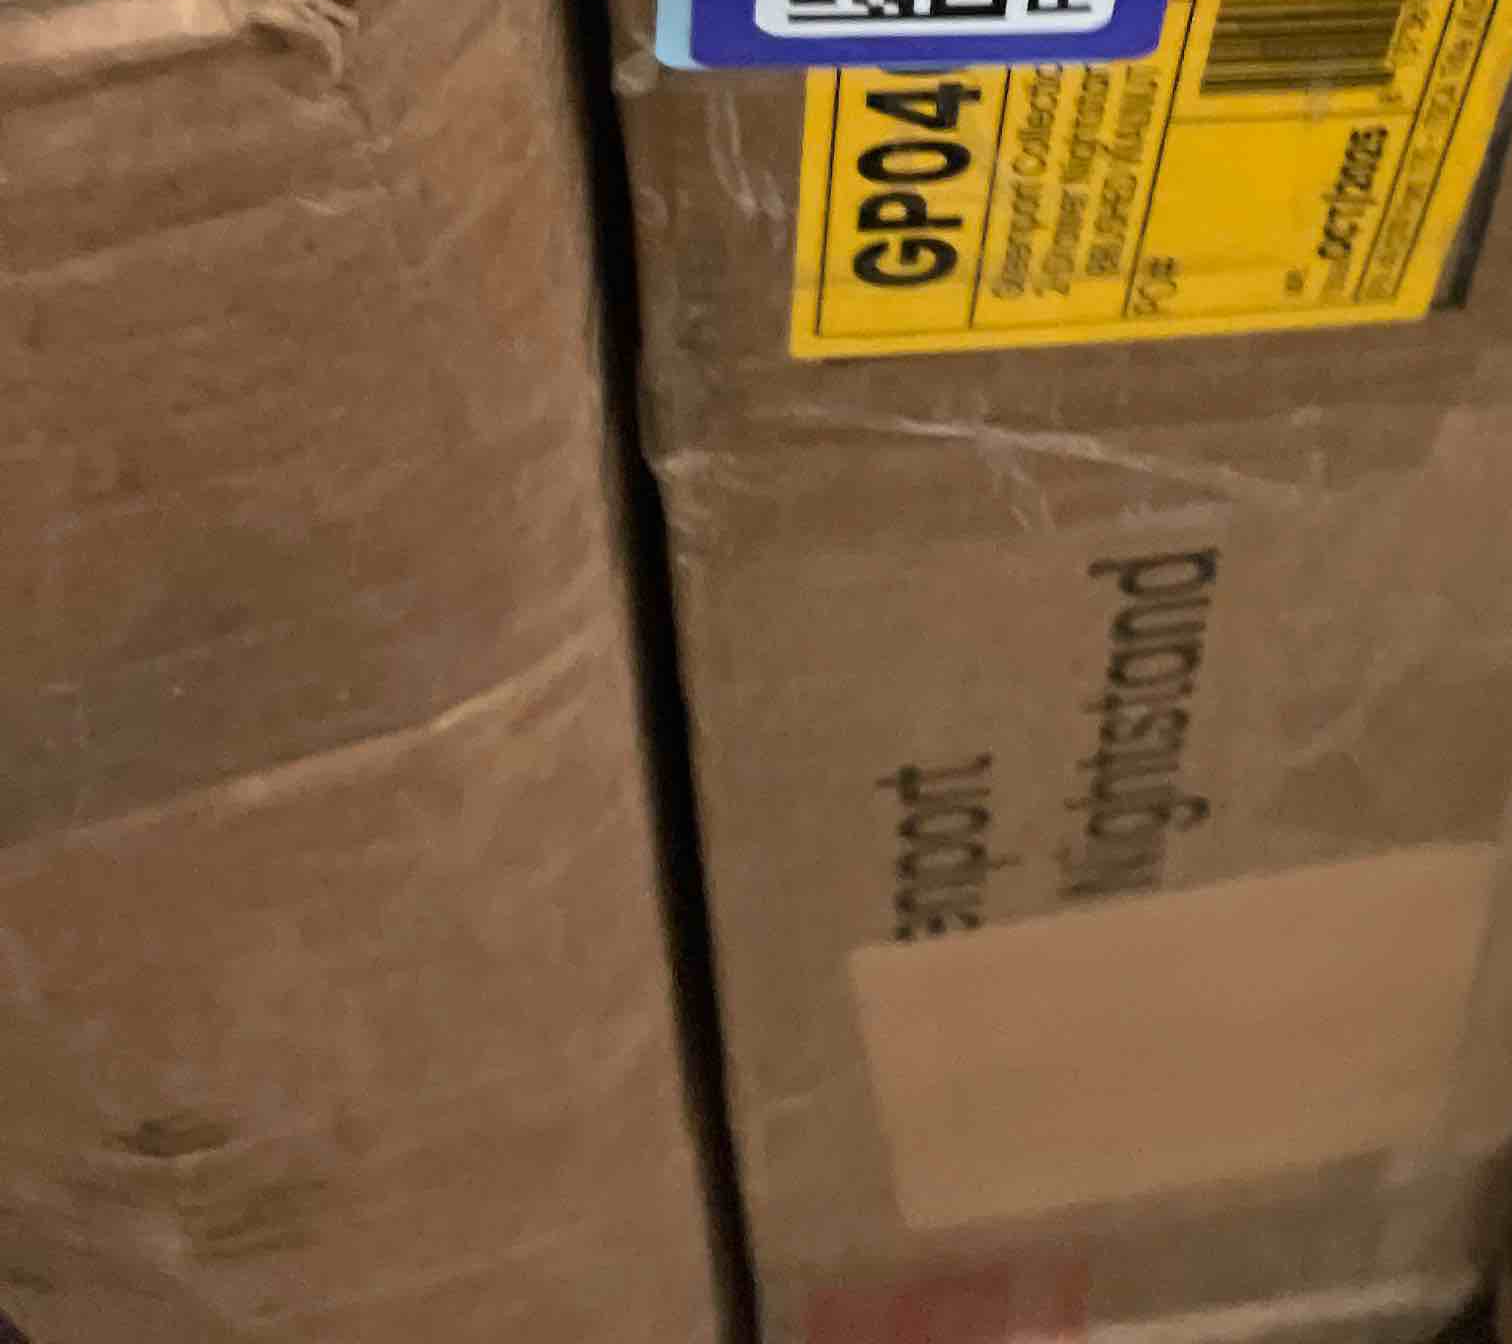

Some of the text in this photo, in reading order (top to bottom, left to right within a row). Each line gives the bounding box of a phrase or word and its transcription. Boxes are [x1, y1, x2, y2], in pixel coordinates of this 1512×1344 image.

[853, 64, 981, 287] GP04
[1010, 64, 1063, 177] Collectio
[1057, 65, 1109, 185] Nightstan
[1316, 126, 1389, 261] OCT/2025
